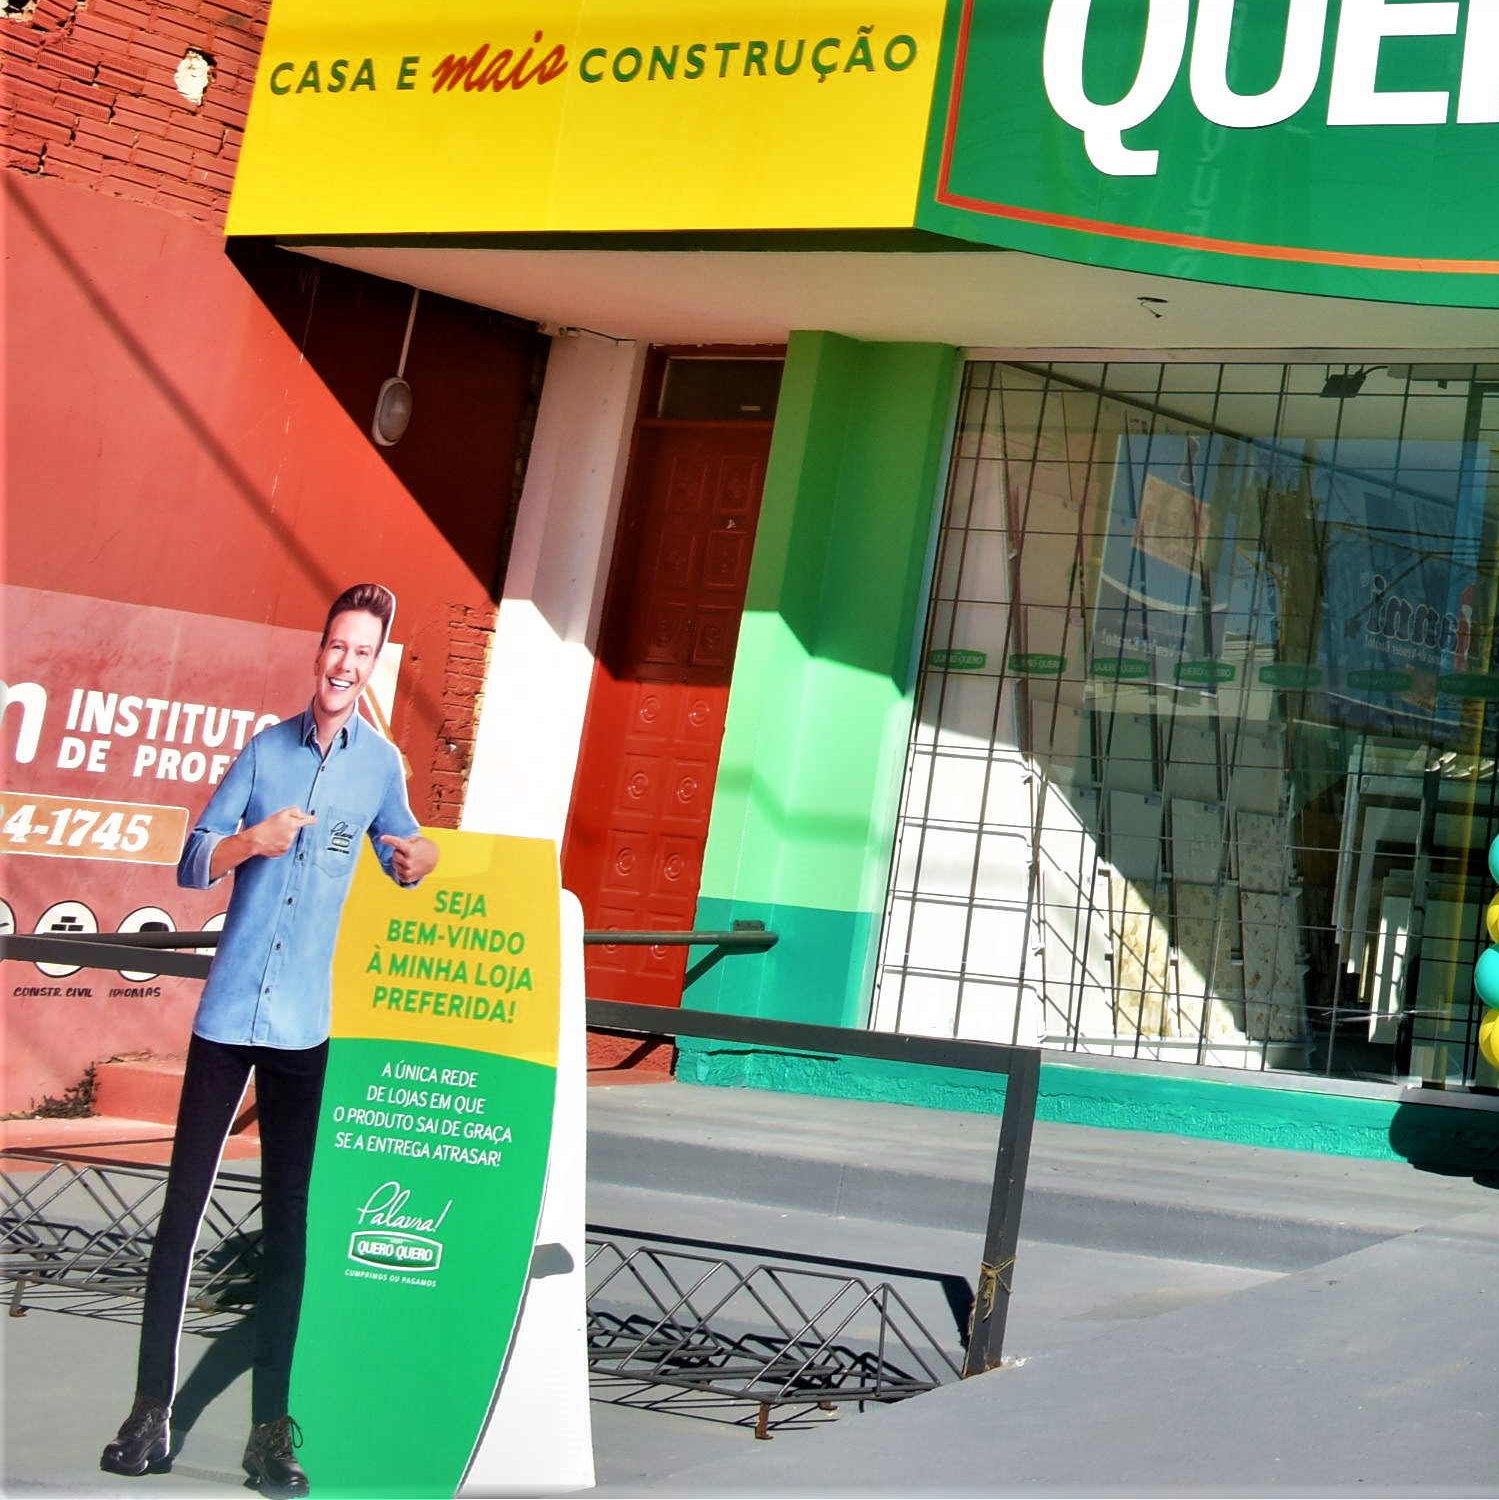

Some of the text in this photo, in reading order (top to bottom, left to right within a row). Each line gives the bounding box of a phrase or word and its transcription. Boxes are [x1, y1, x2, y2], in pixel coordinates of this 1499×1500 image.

[270, 25, 918, 96] CASA E mais CONSTRUÇÃO
[57, 737, 237, 785] DE PROF
[434, 890, 487, 920] SEJA
[387, 919, 525, 955] BEM-VINDO
[366, 944, 533, 994] À MINHA LOJA
[66, 987, 93, 998] CIVIL
[109, 987, 161, 998] IDIOMAS
[372, 986, 516, 1023] PREFERIDA!
[381, 1060, 478, 1088] A ÚNICA REDE
[367, 1085, 486, 1115] DE LOJAS EM QUE
[333, 1106, 513, 1145] O PRODUTO SAI DE GRAÇA
[335, 1132, 502, 1168] SE A ENTREGA ATRASAR!
[357, 1181, 453, 1233] Palavra!
[357, 1240, 433, 1262] QUERO QUERO
